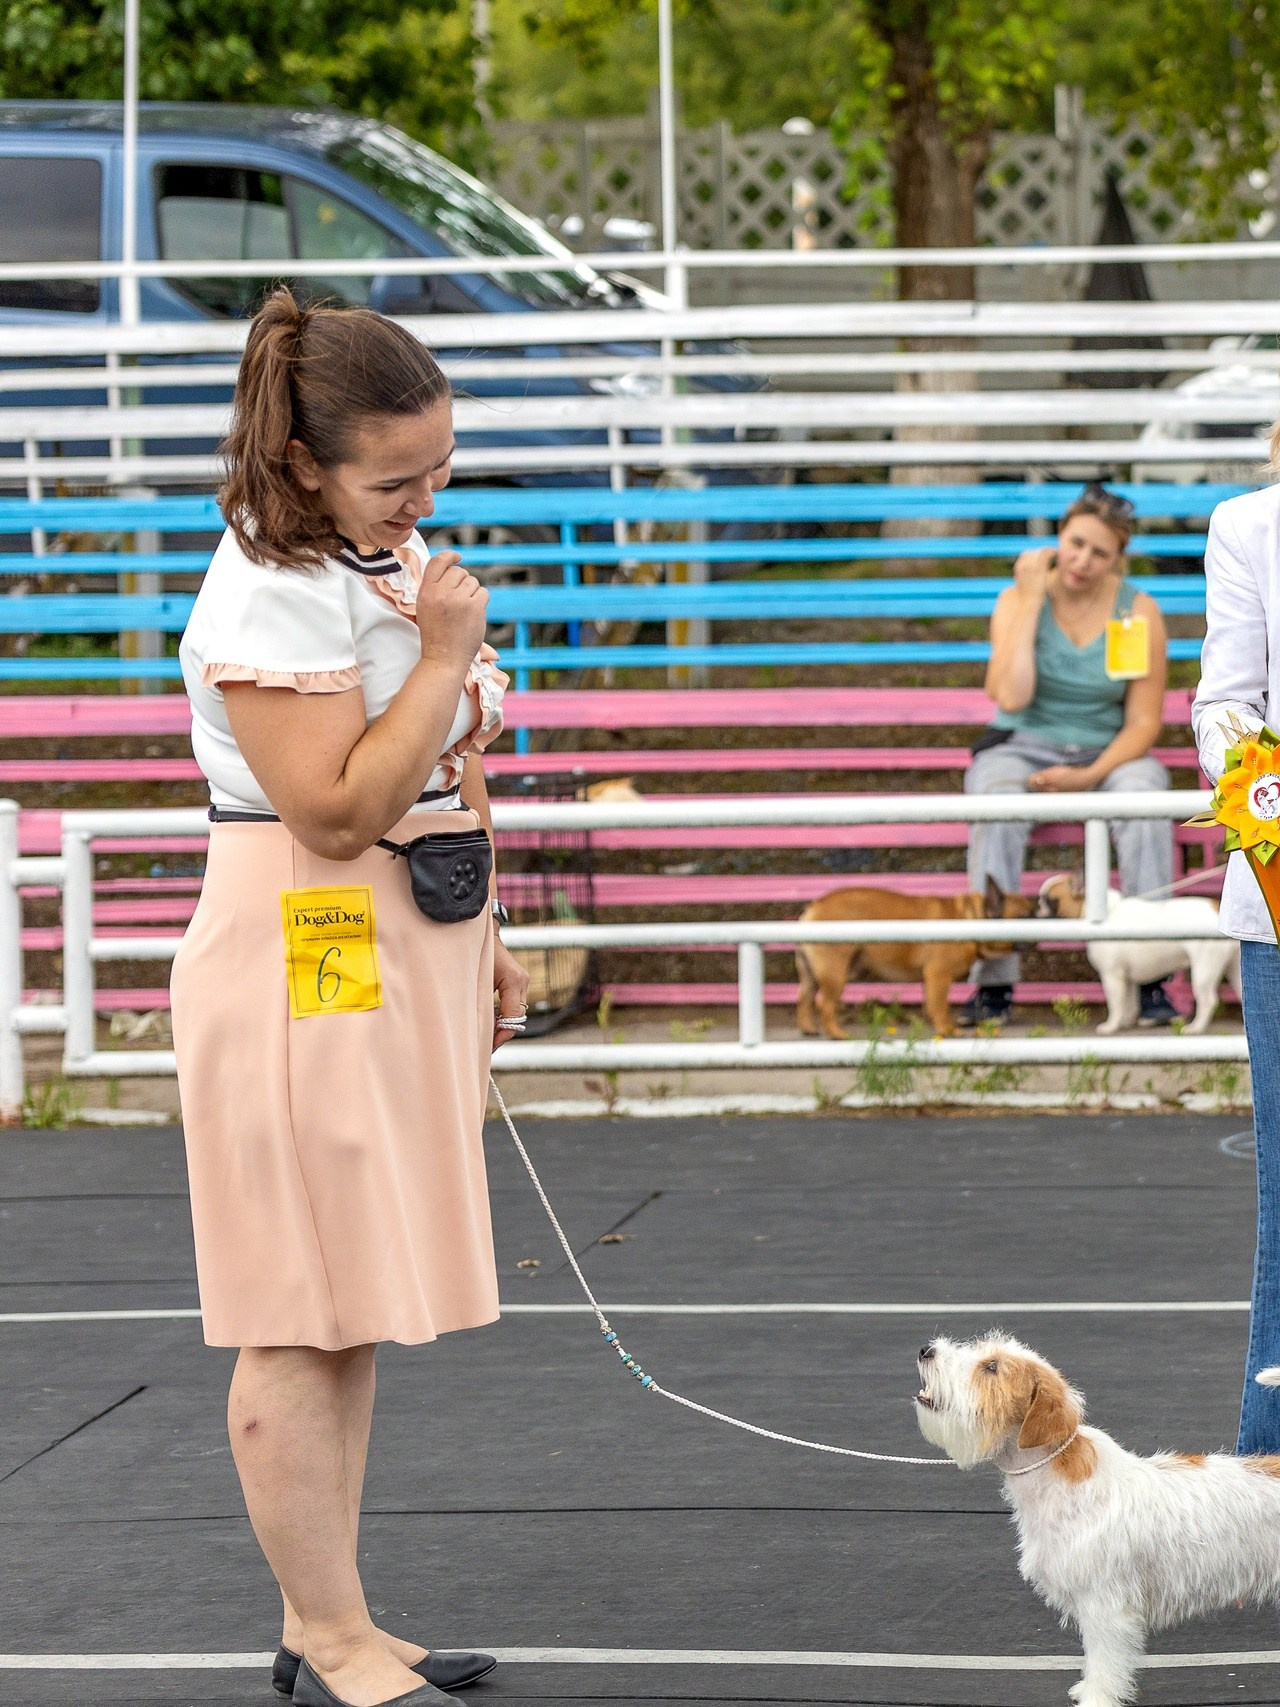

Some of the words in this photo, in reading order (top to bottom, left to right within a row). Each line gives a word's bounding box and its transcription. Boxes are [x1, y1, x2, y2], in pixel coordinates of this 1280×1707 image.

[314, 905, 341, 913] premium
[295, 911, 364, 927] Dog&Dog
[317, 946, 341, 1003] 6
